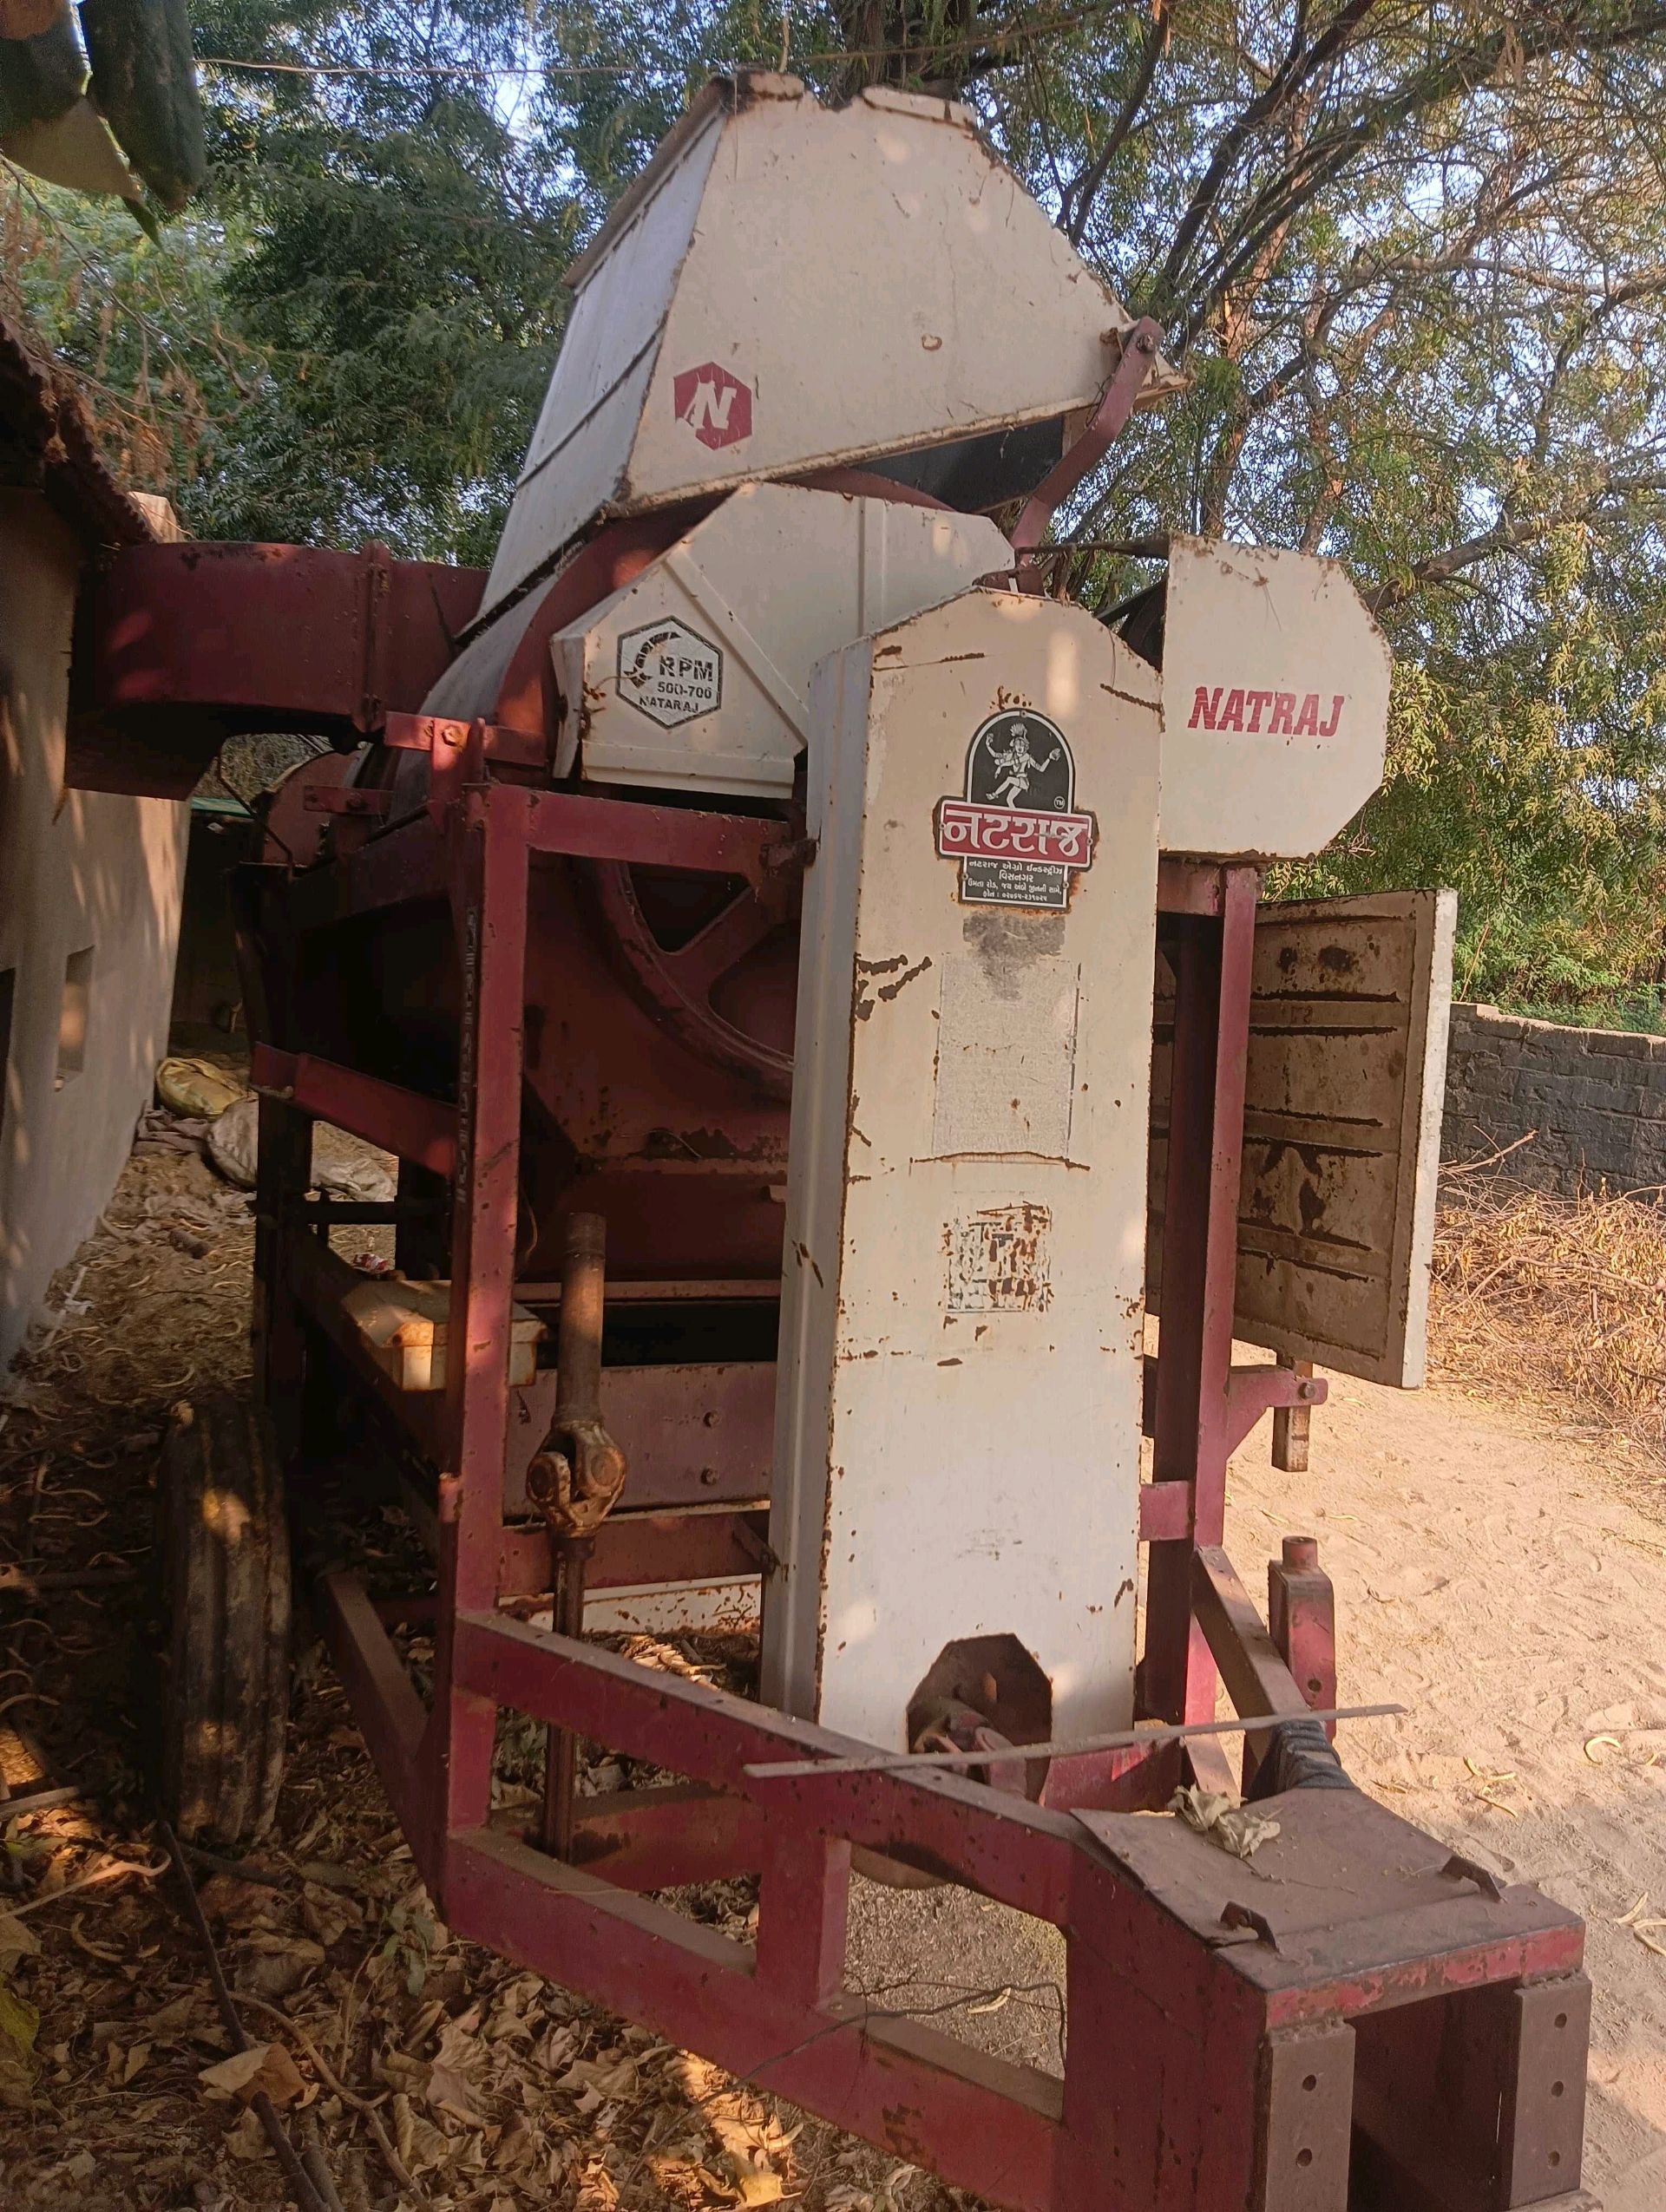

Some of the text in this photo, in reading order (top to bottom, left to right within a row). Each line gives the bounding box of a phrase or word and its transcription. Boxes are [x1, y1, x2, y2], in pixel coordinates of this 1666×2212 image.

[659, 656, 713, 681] RPM
[658, 682, 712, 698] 500-700
[640, 697, 699, 713] NATARAJ
[1187, 686, 1345, 736] NATRAJ
[944, 809, 1088, 856] નટરાજ
[999, 869, 1034, 882] વિસનગર
